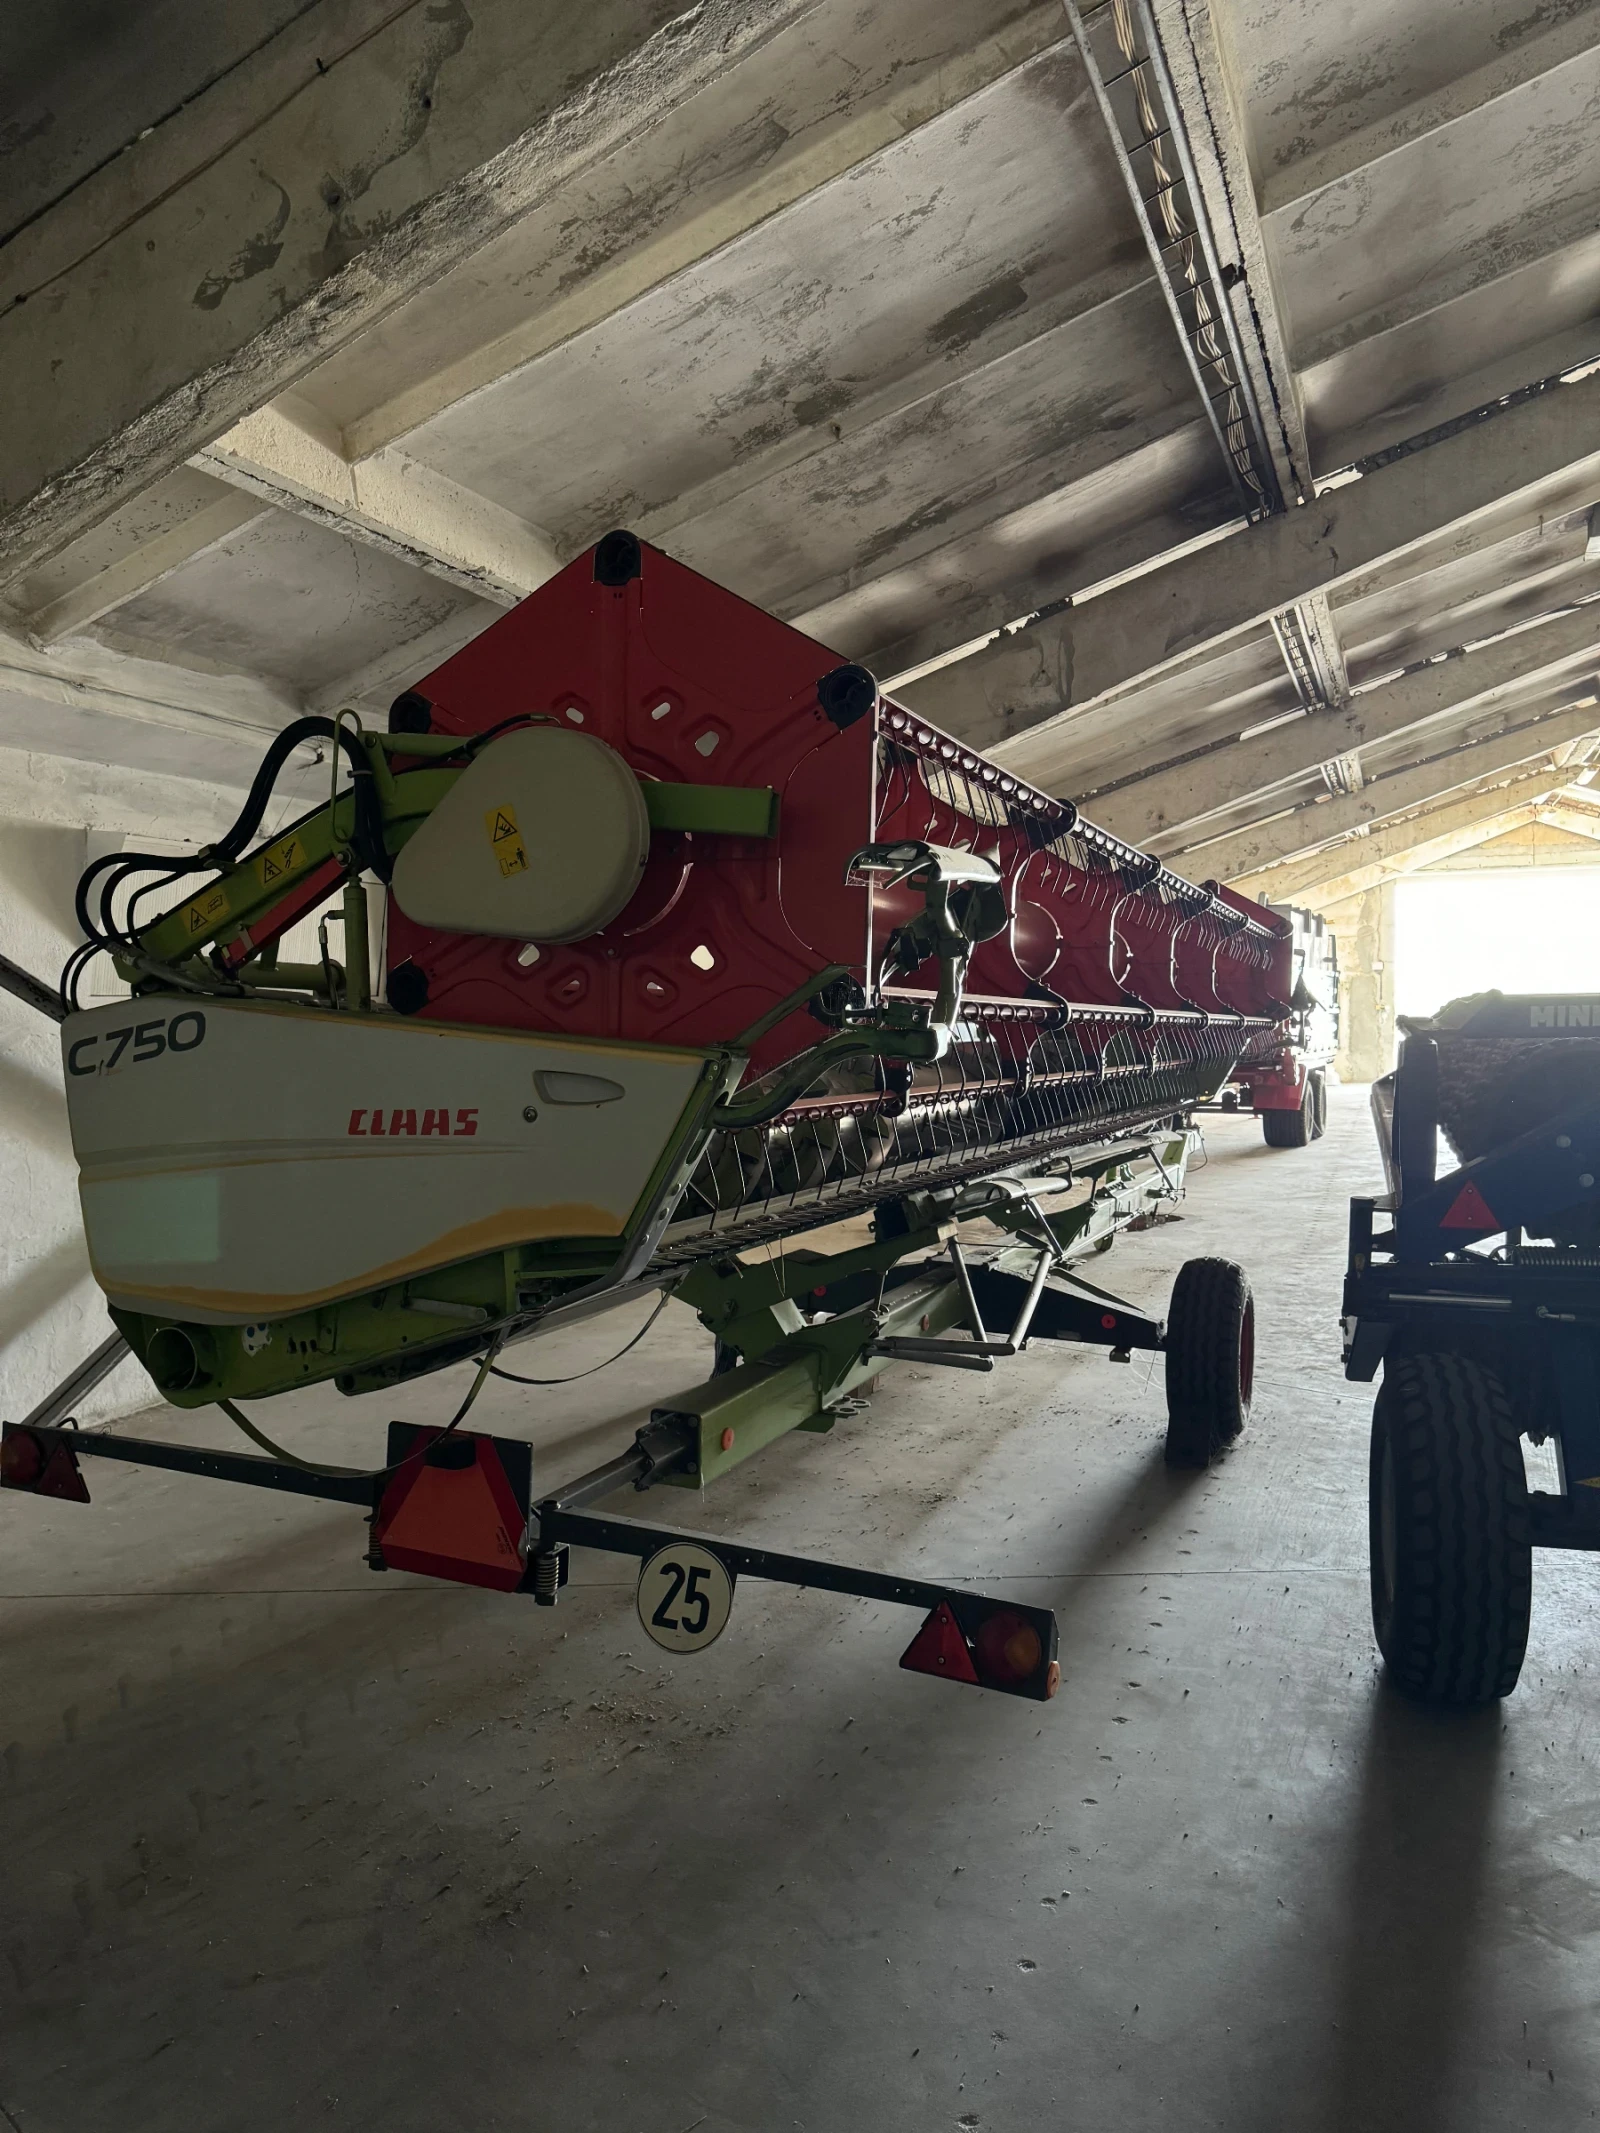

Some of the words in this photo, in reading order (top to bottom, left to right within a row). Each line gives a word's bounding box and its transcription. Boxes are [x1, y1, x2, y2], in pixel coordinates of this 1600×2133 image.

[68, 1011, 206, 1076] C750
[348, 1108, 479, 1136] CLAAS
[652, 1562, 711, 1634] 25
